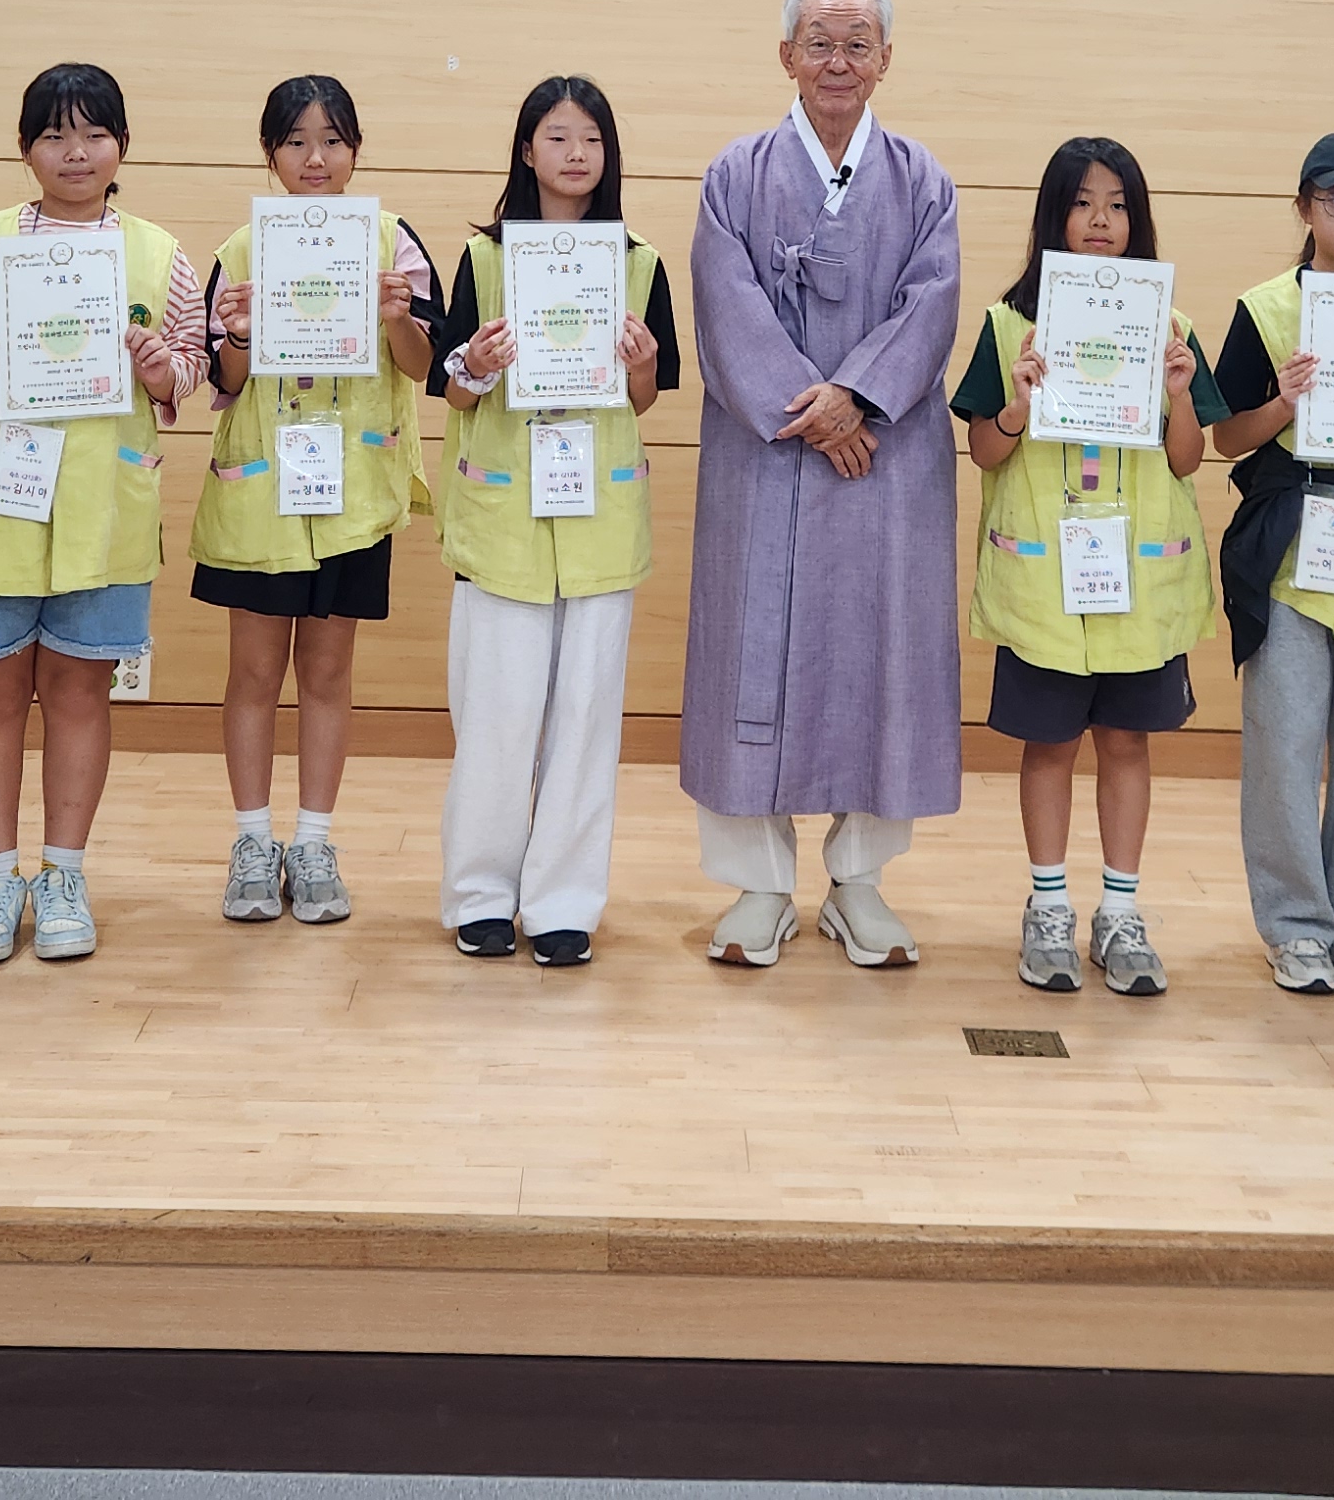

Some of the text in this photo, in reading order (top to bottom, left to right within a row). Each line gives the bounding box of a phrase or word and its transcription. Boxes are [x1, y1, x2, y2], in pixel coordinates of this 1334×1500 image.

[297, 236, 335, 246] 수료증
[546, 263, 583, 274] 수료증
[42, 273, 82, 285] 수료증
[1085, 296, 1124, 310] 수료증
[13, 482, 47, 499] 김시아
[561, 482, 582, 493] 소원
